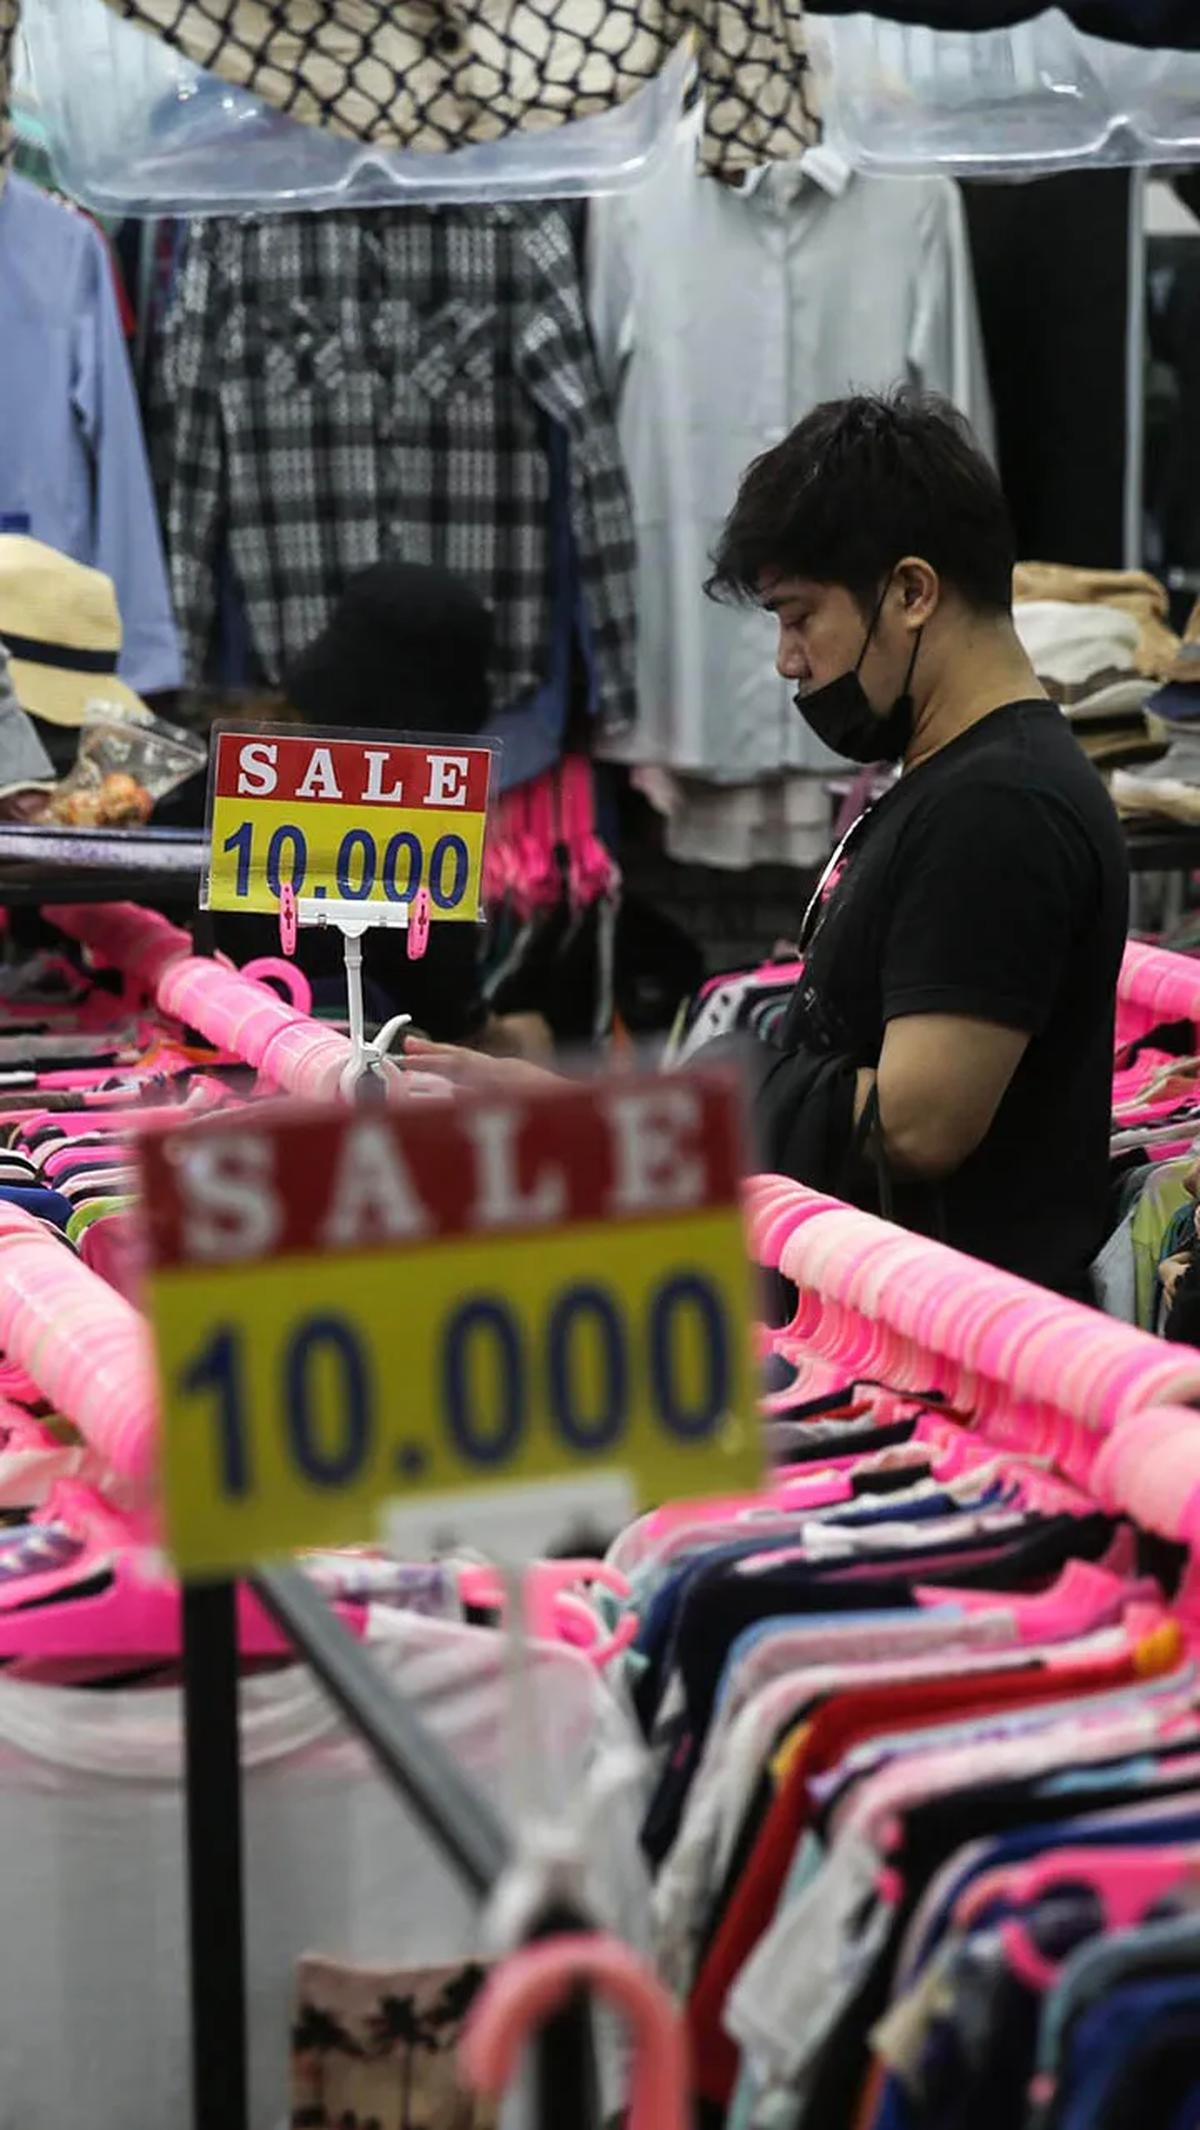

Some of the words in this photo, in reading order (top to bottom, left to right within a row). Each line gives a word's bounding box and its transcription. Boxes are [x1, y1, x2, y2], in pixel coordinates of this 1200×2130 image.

[237, 743, 469, 806] SALE
[224, 822, 469, 909] 10.000
[180, 1088, 706, 1263] SALE
[177, 1266, 730, 1505] 10.000
